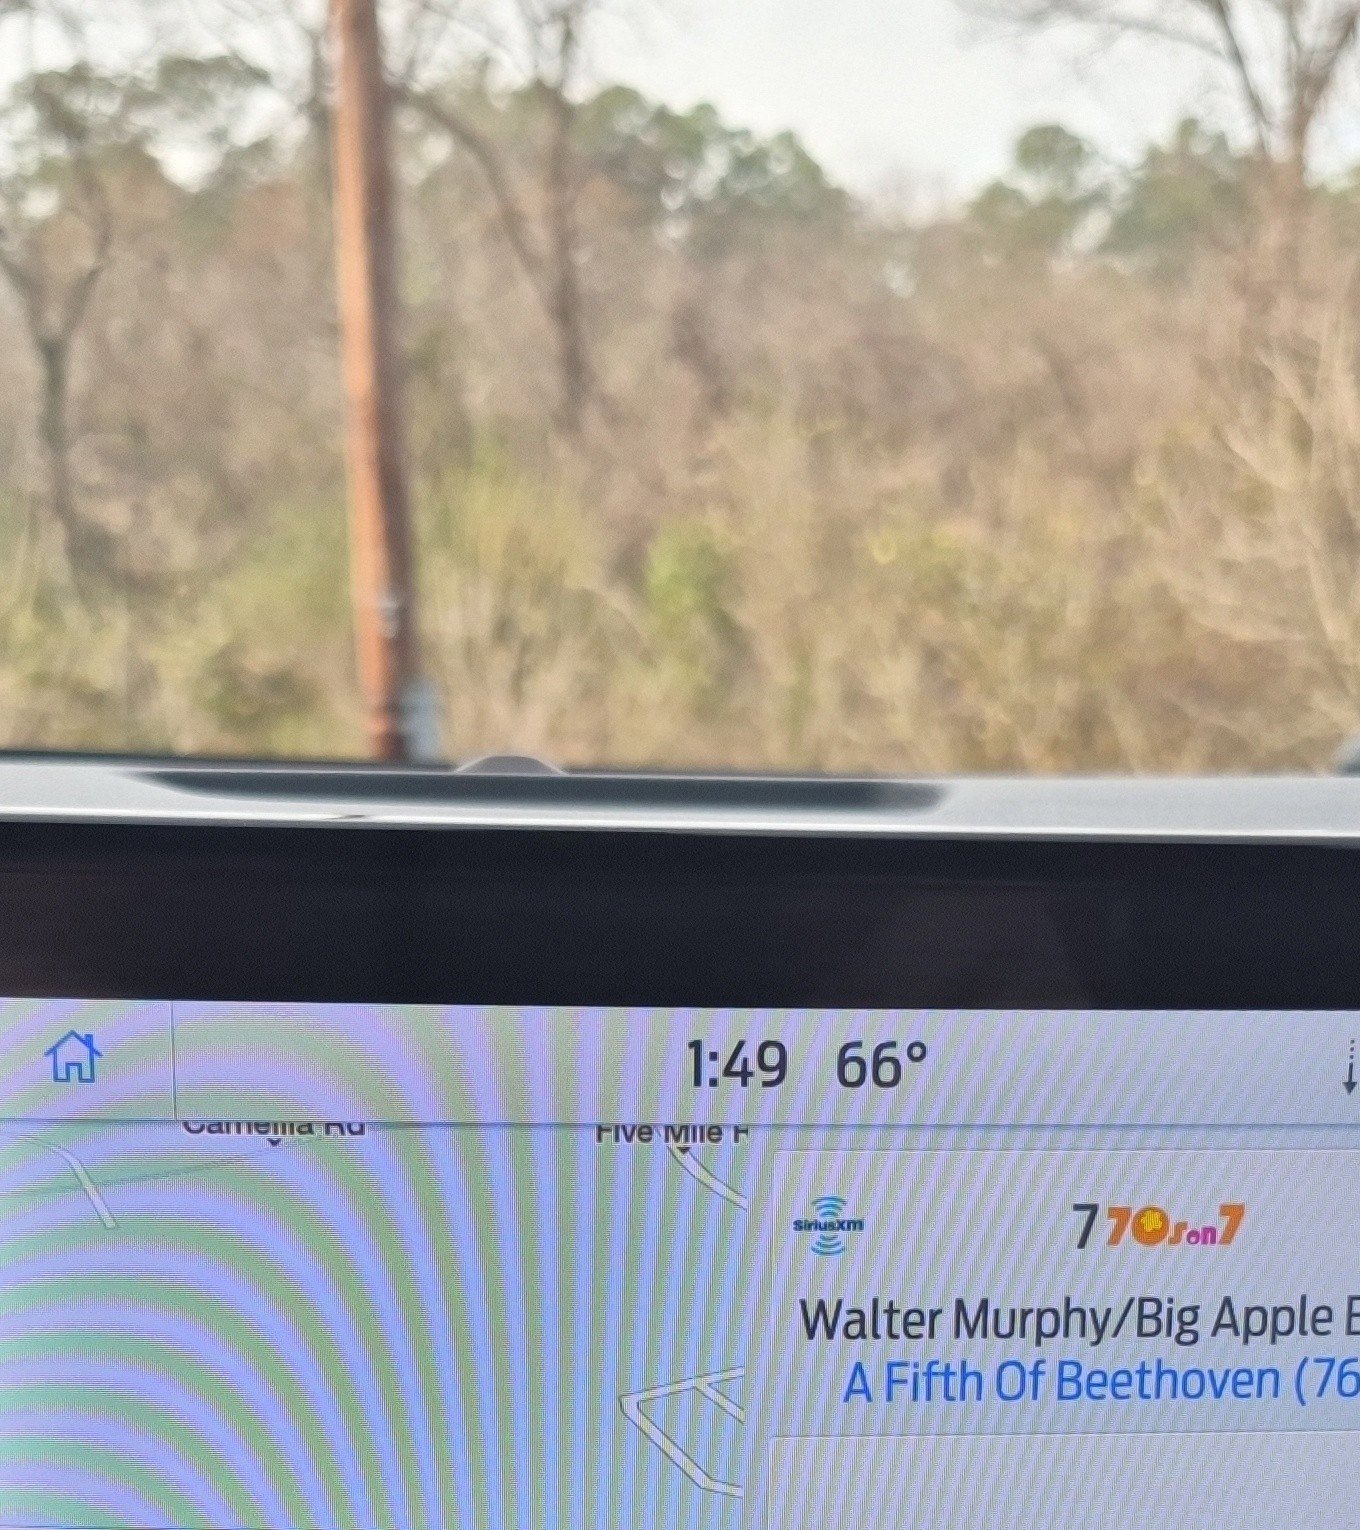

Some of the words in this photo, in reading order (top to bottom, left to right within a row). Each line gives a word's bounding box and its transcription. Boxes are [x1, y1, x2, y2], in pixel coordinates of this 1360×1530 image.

[686, 1039, 788, 1088] 1:49
[836, 1040, 928, 1089] 66°
[1072, 1203, 1099, 1250] 7
[799, 1297, 943, 1341] Walter
[953, 1295, 1200, 1347] Murphy/Big
[1211, 1294, 1334, 1346] Apple
[843, 1361, 873, 1403] A
[885, 1359, 984, 1403] Fifth
[995, 1358, 1046, 1402] Of
[1057, 1358, 1281, 1402] Beethoven
